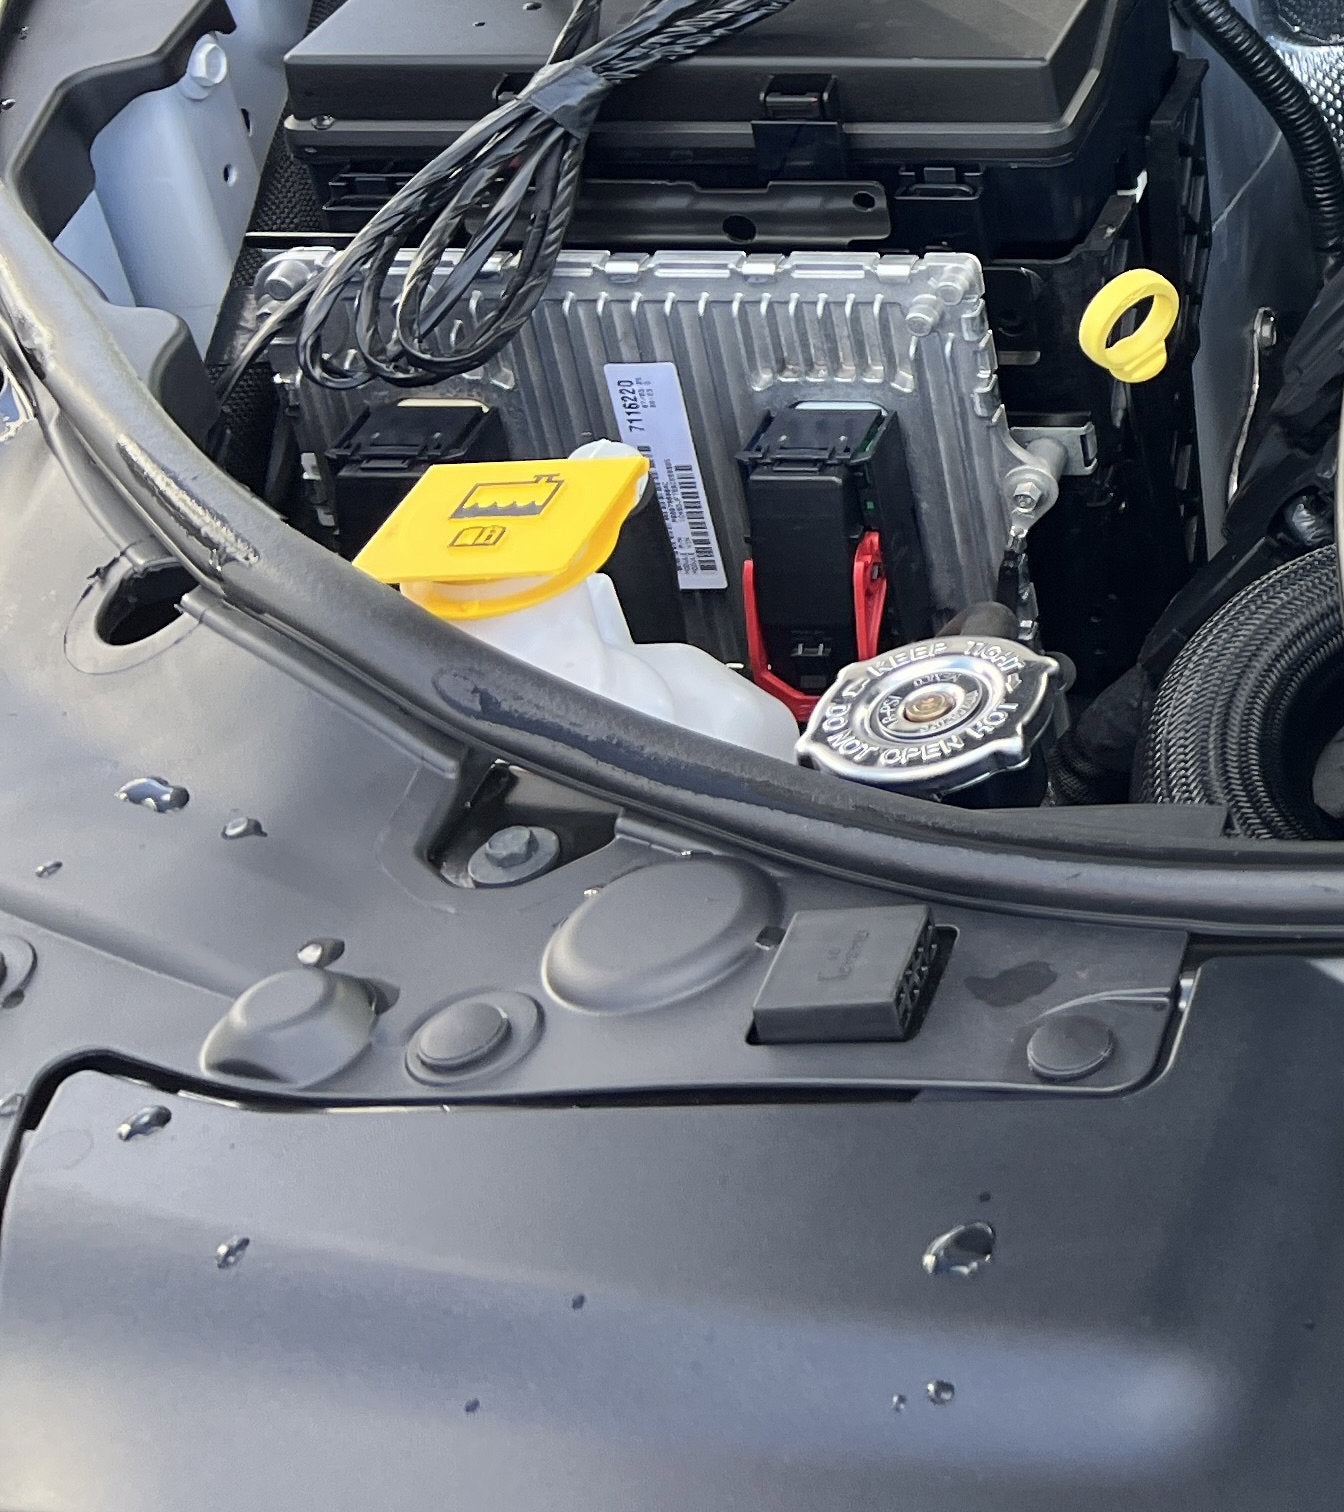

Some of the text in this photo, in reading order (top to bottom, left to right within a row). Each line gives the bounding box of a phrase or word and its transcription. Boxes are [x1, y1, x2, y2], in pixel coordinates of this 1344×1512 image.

[617, 380, 645, 432] 7116220
[866, 640, 1026, 677] KEEP TIGHT
[822, 704, 849, 731] DO
[966, 701, 1020, 737] HOT
[827, 730, 880, 761] NOT
[879, 735, 965, 766] OPEN
